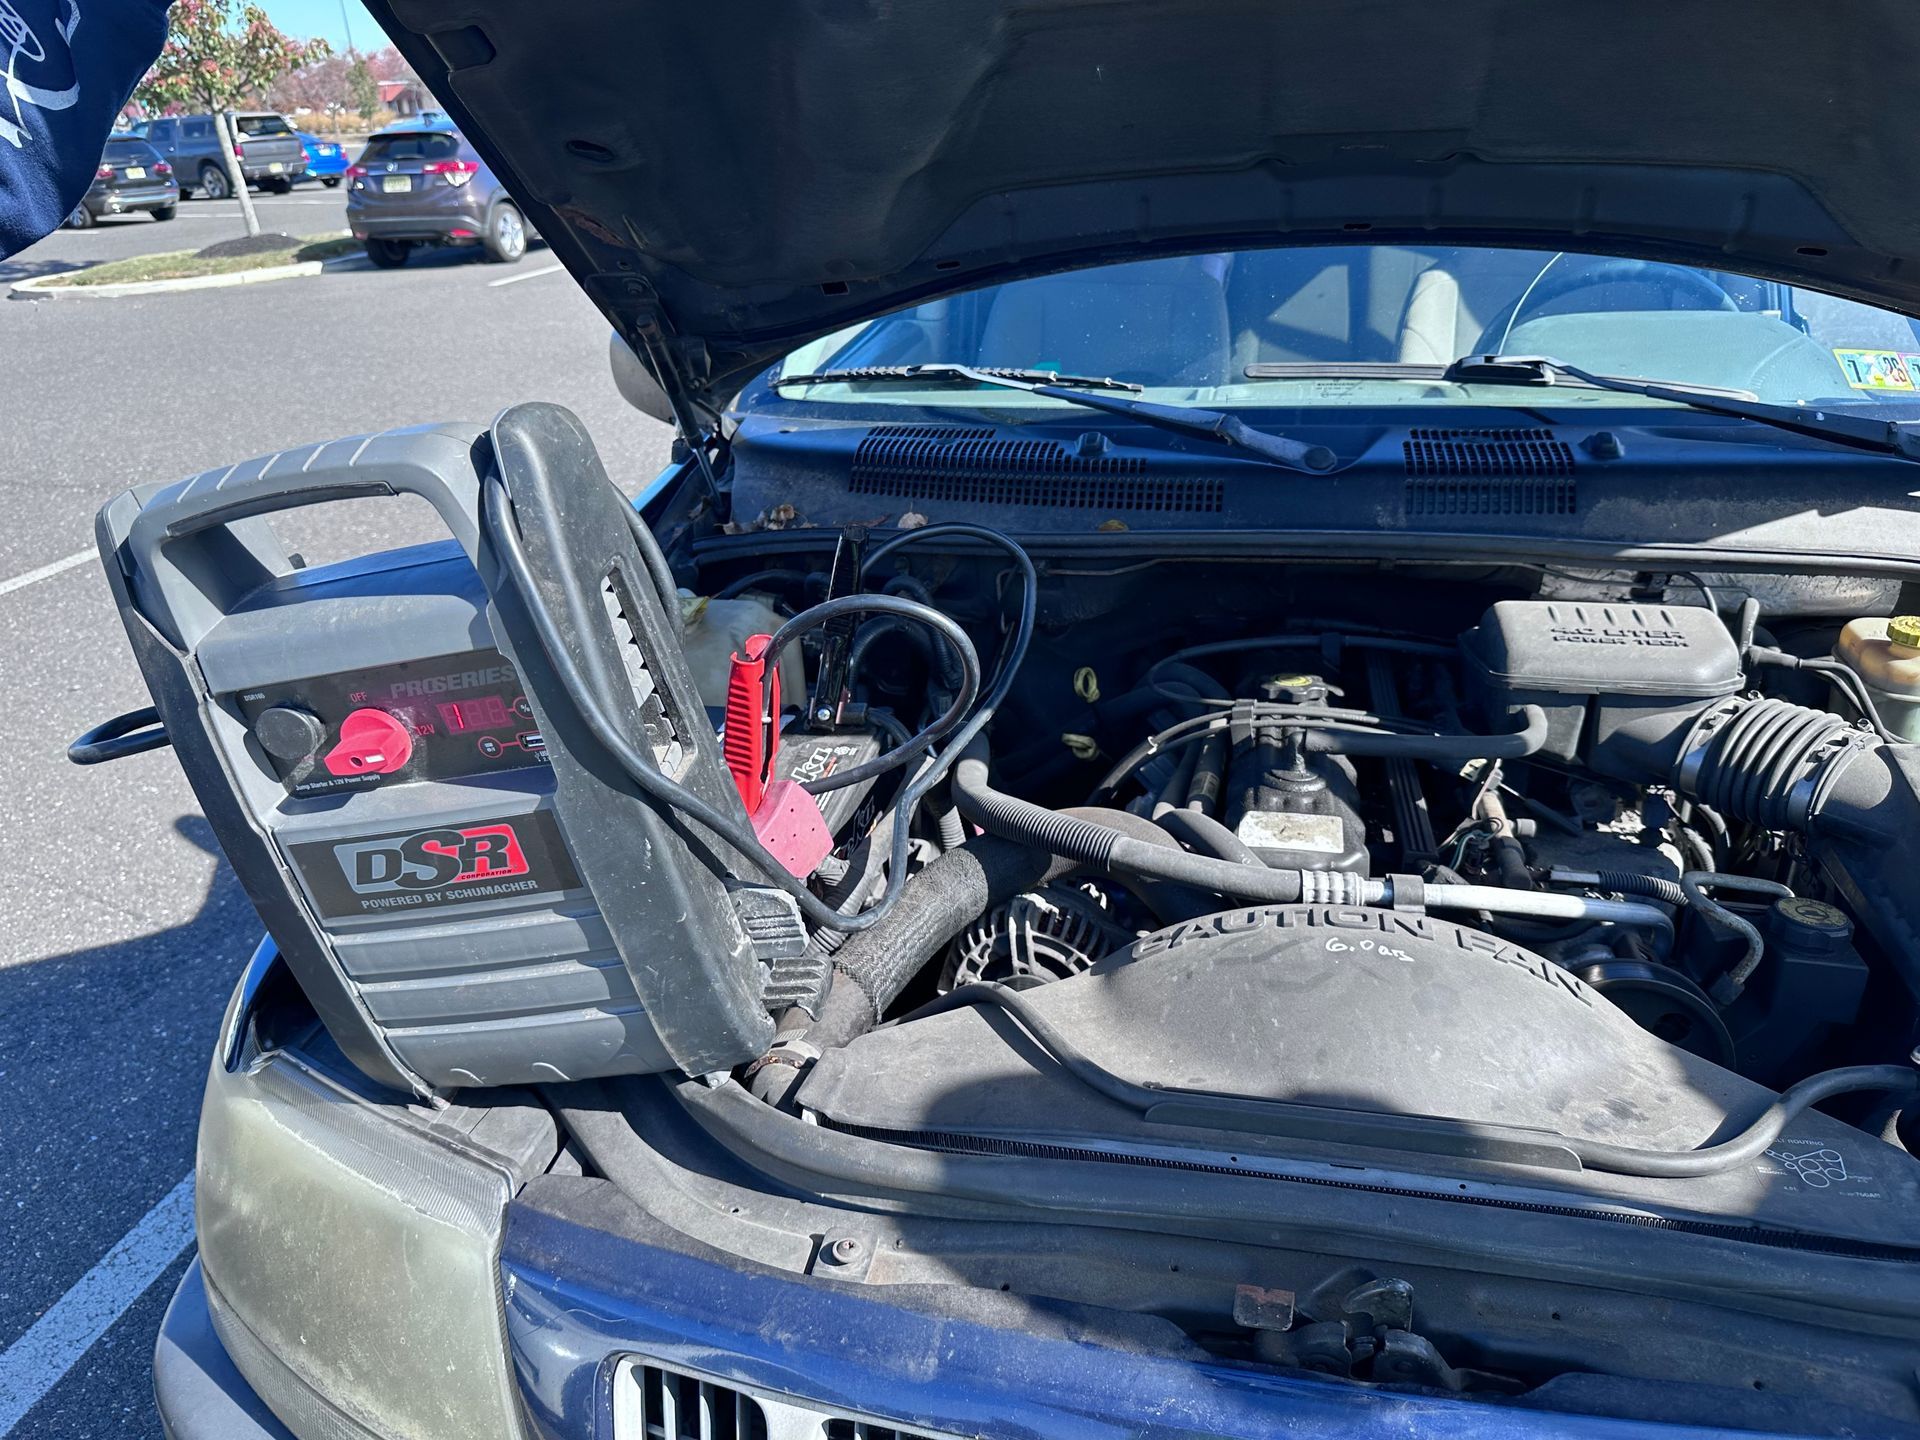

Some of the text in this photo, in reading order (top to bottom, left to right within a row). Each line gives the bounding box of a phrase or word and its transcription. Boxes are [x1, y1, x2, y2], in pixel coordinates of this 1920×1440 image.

[1847, 359, 1862, 383] 7
[1602, 628, 1685, 639] LITER
[1552, 636, 1690, 648] POWER TECH
[350, 691, 368, 703] OFF
[415, 724, 435, 736] 12V
[295, 783, 311, 791] Jump
[310, 780, 328, 790] Starter
[334, 778, 344, 786] 12V
[344, 776, 362, 785] Power
[361, 774, 381, 783] Supply
[354, 829, 510, 890] DSR
[461, 869, 513, 880] CORPORATION
[361, 879, 539, 910] POWERED BY SCHUMACHER
[1325, 937, 1375, 952] 6.0
[1131, 906, 1594, 1008] CAUTION FAN
[1787, 1138, 1825, 1147] ROUTING
